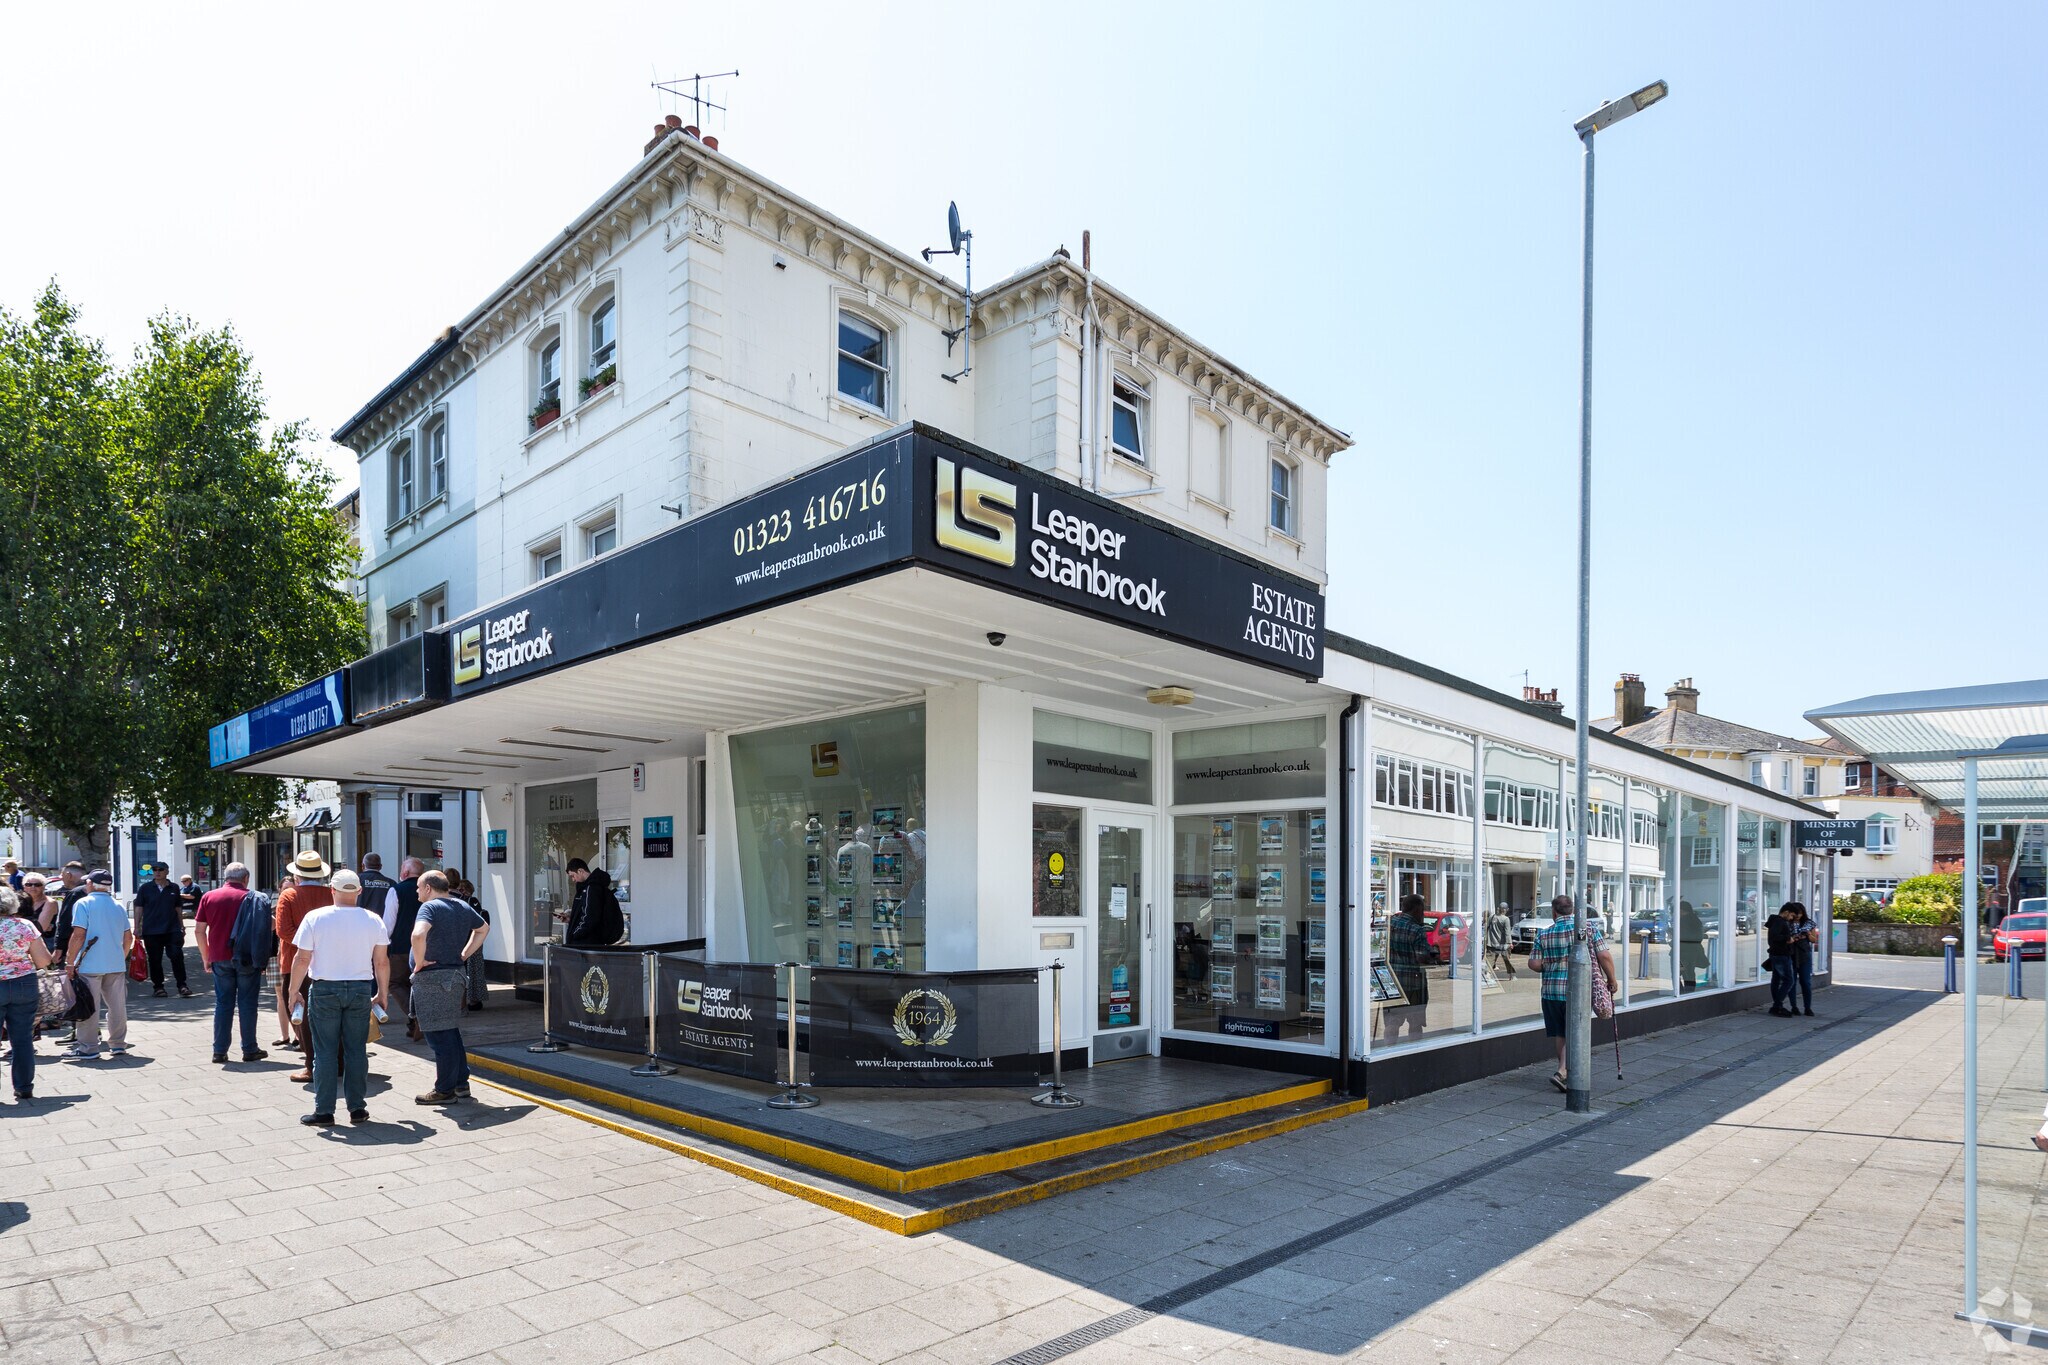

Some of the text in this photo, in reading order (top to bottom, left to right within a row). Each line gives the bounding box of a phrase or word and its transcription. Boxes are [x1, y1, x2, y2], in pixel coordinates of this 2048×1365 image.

[733, 468, 886, 556] 01323 416716
[1031, 492, 1126, 560] Leaper
[735, 520, 886, 586] www.leaperstanbrook.co.uk
[1030, 538, 1167, 617] Stanbrook
[1251, 582, 1316, 630] ESTATE
[485, 608, 530, 645] Leaper
[1243, 615, 1315, 661] AGENTS
[485, 627, 553, 675] Stanbrook
[290, 713, 307, 737] 01323
[1046, 757, 1138, 779] www.leaperstanbrook.co.uk
[1185, 760, 1311, 780] www.leaperstanbrook.co.uk
[1803, 820, 1859, 829] MINISTRY
[1820, 830, 1837, 838] OF
[647, 843, 669, 853] LETTINGS
[1804, 839, 1857, 847] BARBERS
[703, 982, 732, 1003] Leaper
[701, 1000, 753, 1021] Stanbrook
[908, 1011, 941, 1026] 1964
[1224, 1021, 1265, 1034] rightmove
[685, 1029, 748, 1049] ESTATE AGENTS
[855, 1057, 994, 1071] www.leaperstanbrook.co.uk
